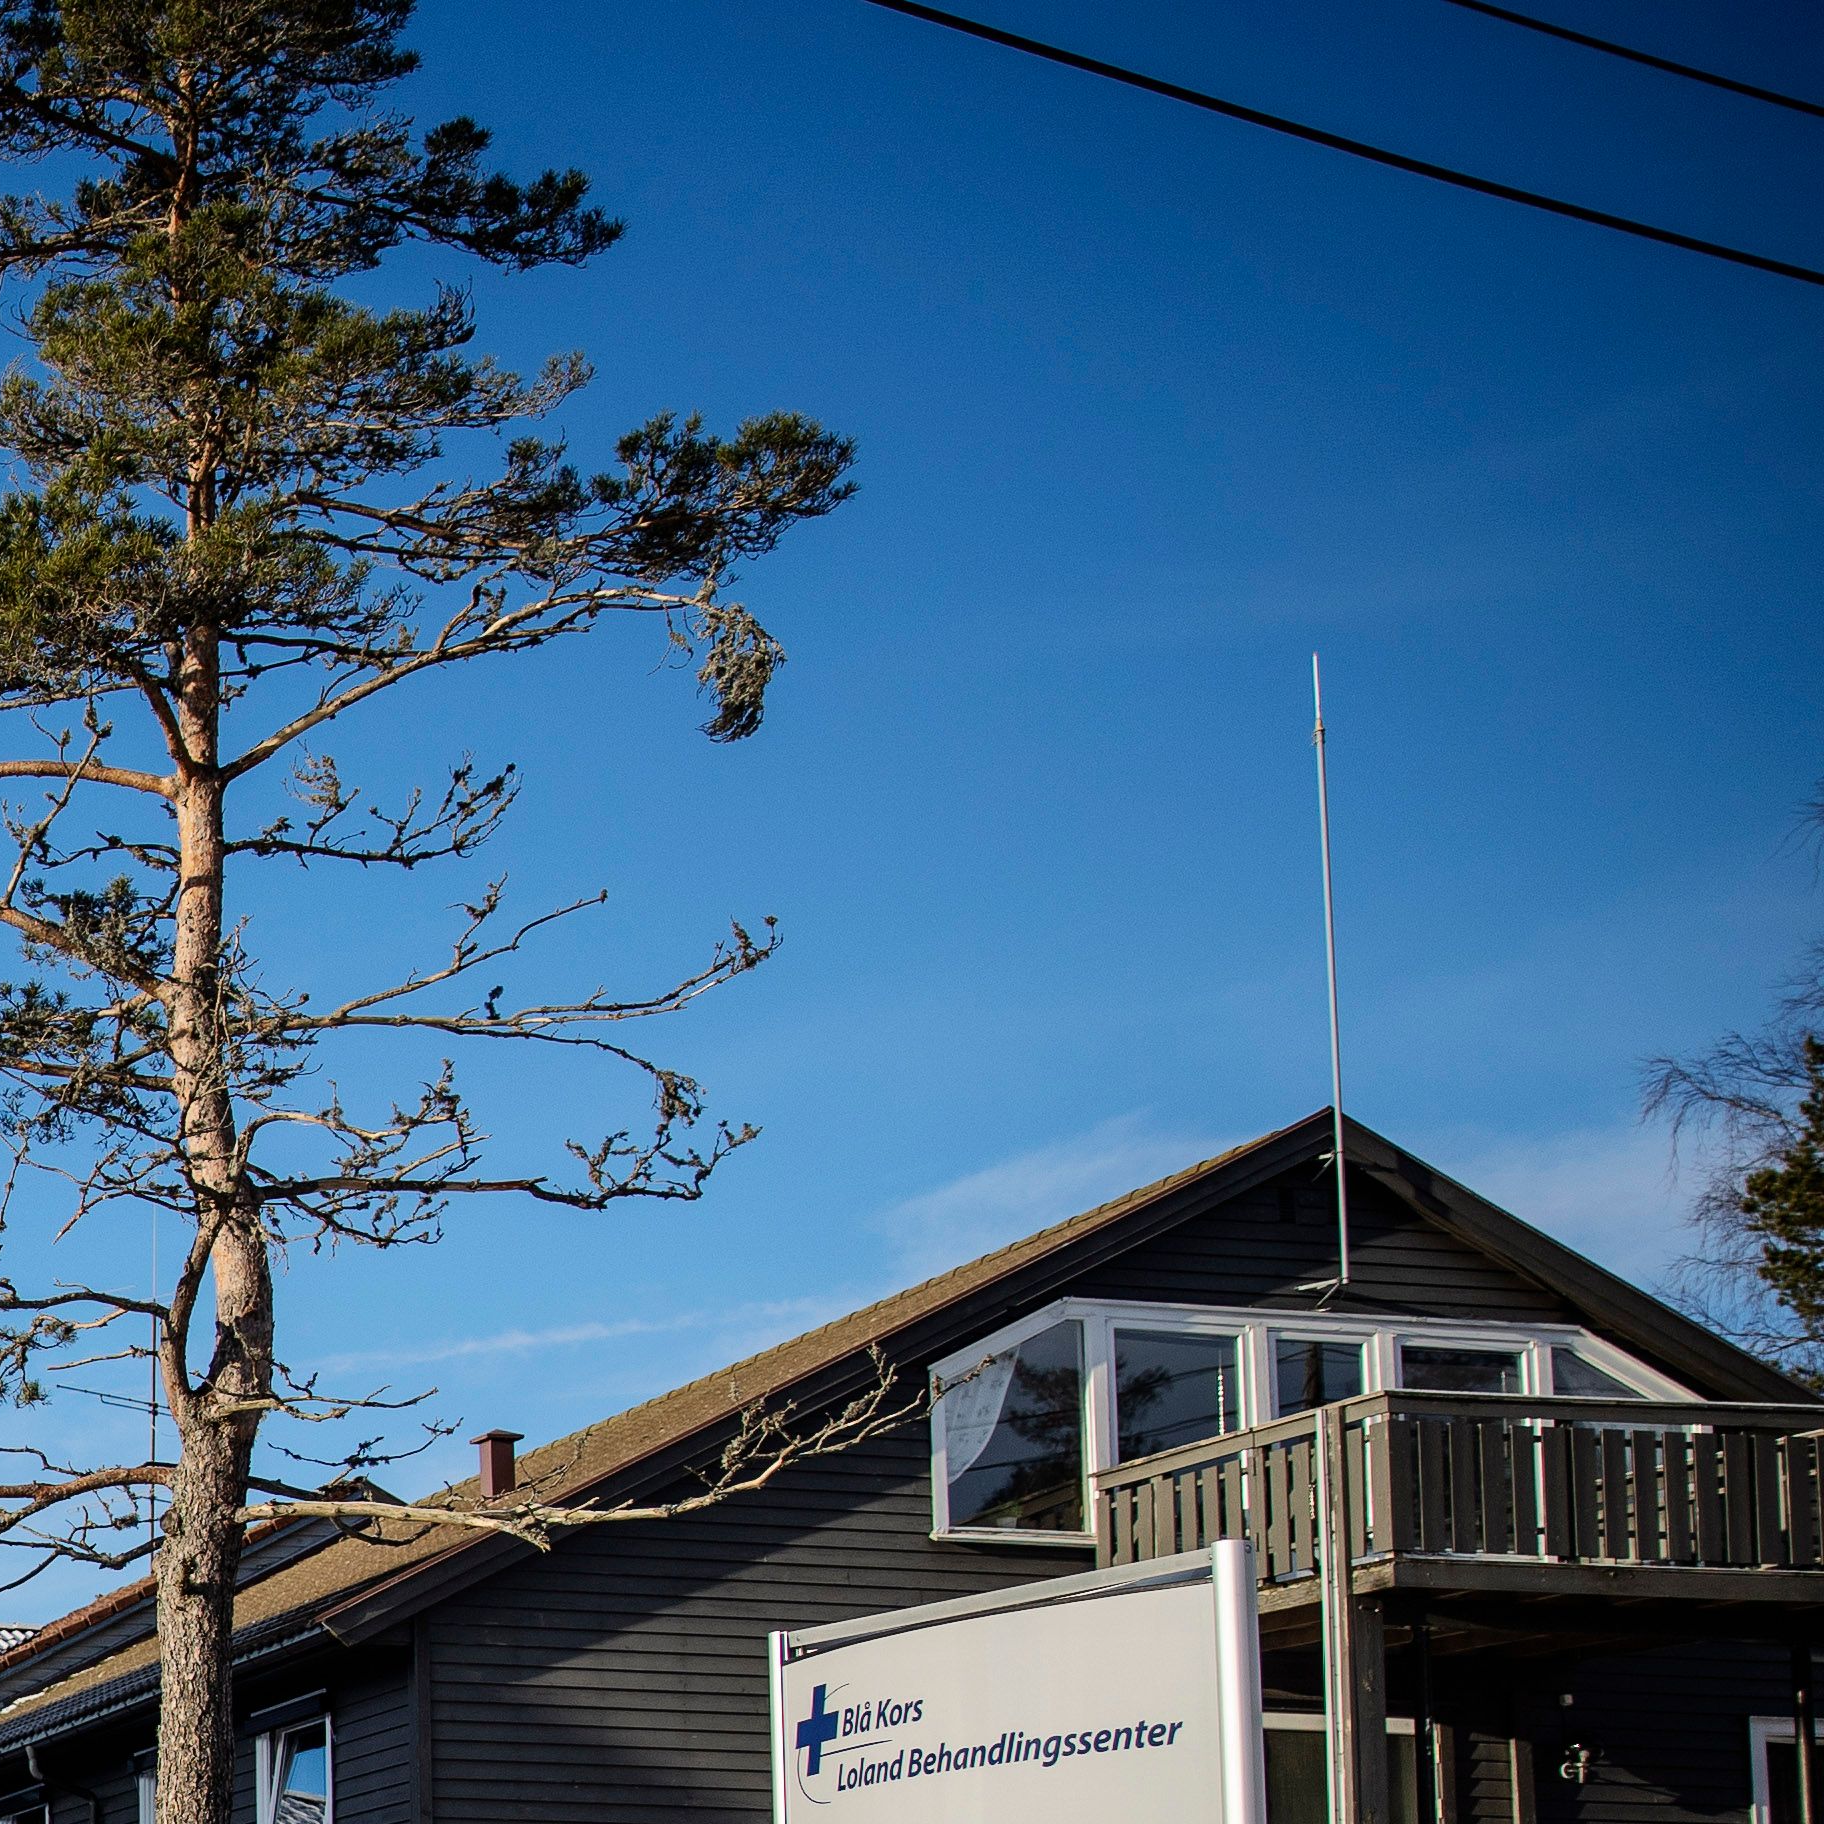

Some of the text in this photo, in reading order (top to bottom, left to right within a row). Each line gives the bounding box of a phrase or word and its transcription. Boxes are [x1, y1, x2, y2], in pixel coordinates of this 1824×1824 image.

[842, 1698, 924, 1737] Blå Kors
[837, 1719, 1184, 1791] Loland Behandlingssenter
